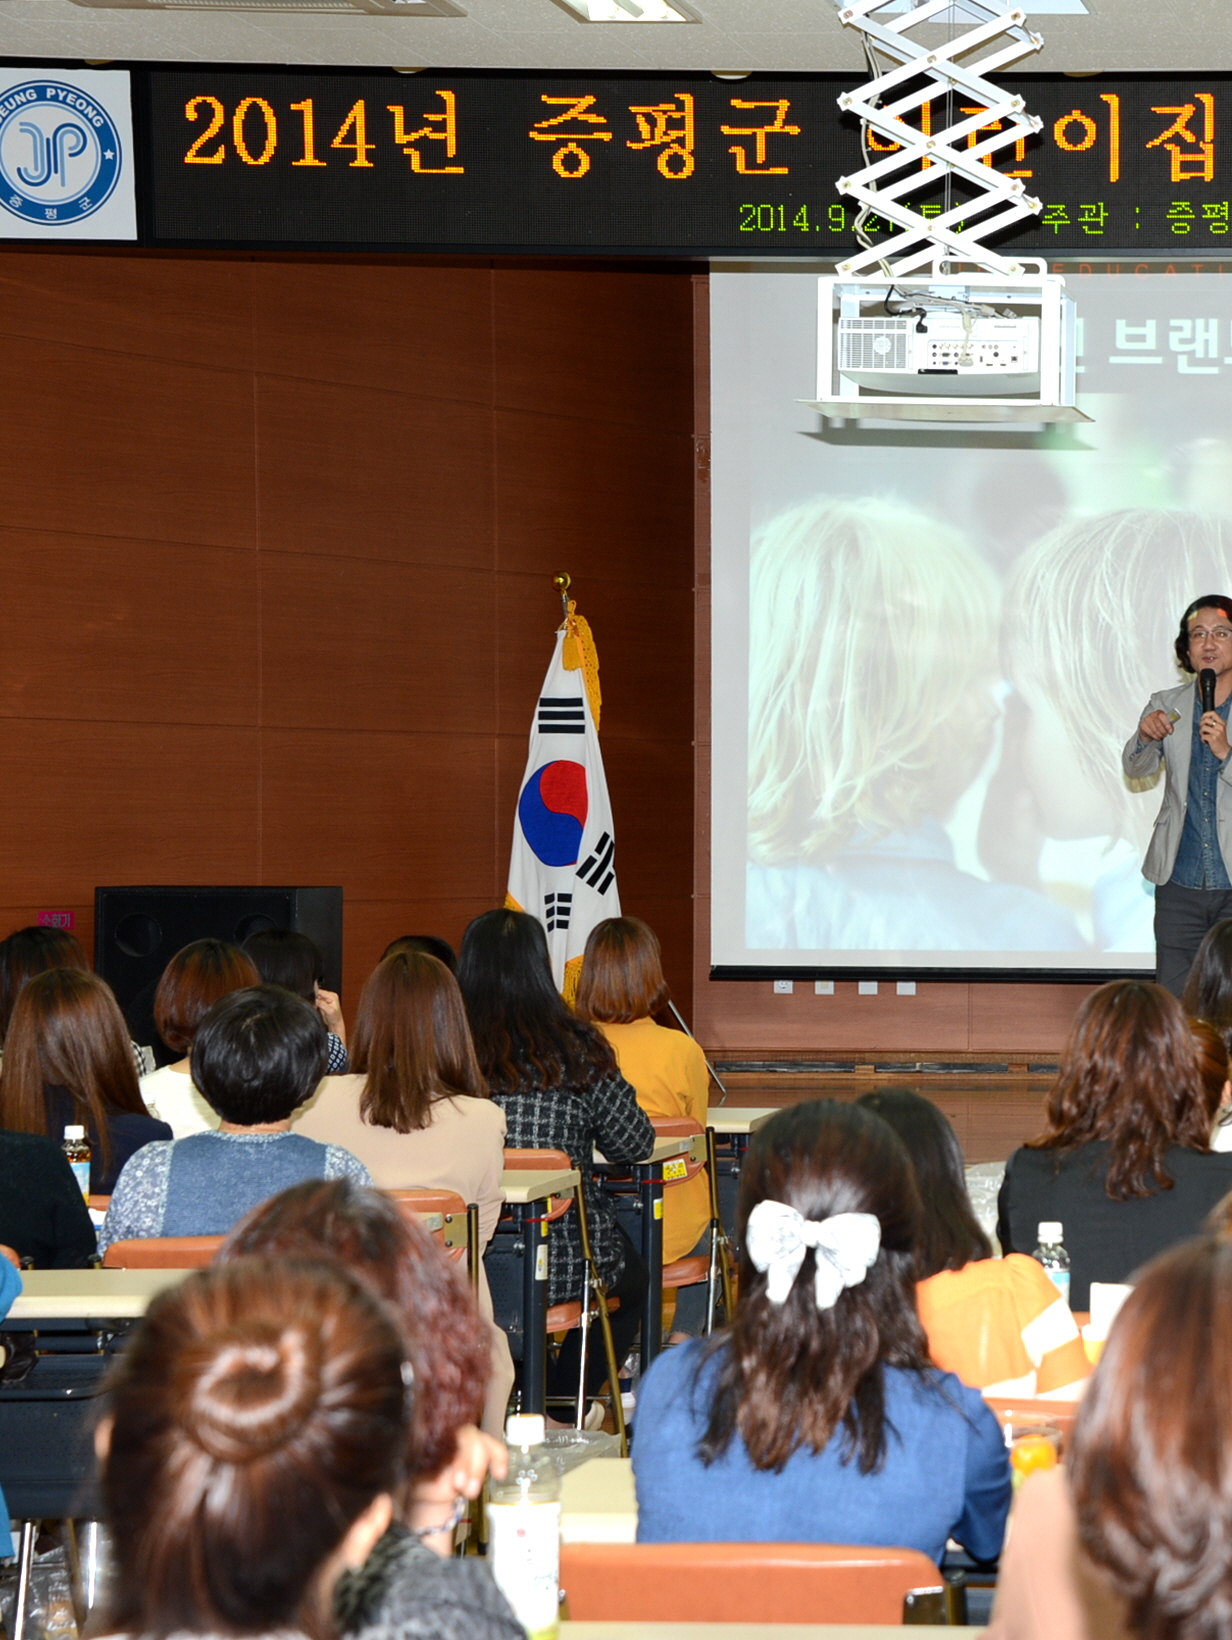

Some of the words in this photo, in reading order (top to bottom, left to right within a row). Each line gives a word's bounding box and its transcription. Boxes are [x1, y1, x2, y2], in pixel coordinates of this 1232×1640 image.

[0, 89, 37, 122] EUNG
[46, 88, 104, 128] PYEONG
[183, 90, 464, 173] 2014년
[529, 93, 801, 178] 증평군
[1041, 201, 1109, 234] 주관
